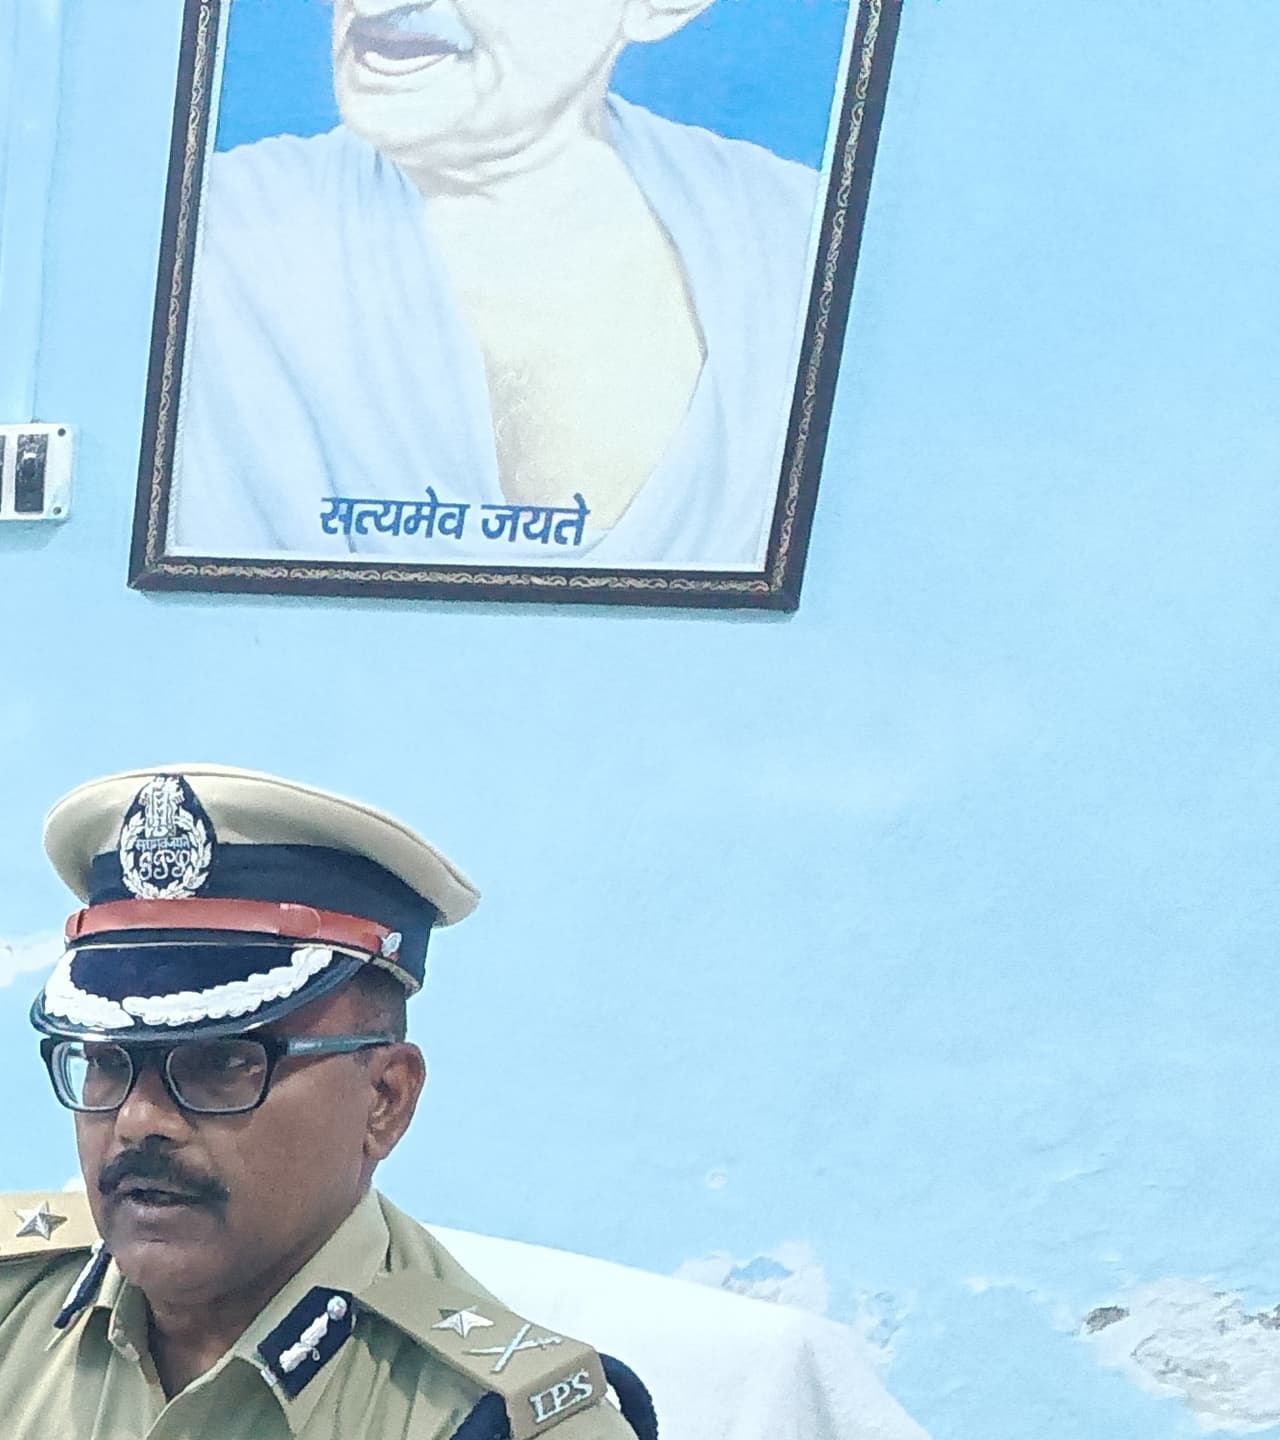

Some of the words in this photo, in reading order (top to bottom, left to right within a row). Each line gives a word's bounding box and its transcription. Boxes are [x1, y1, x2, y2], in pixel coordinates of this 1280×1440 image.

[320, 486, 470, 540] सत्यमेव
[481, 492, 591, 546] जयते
[529, 1368, 593, 1425] IPS
